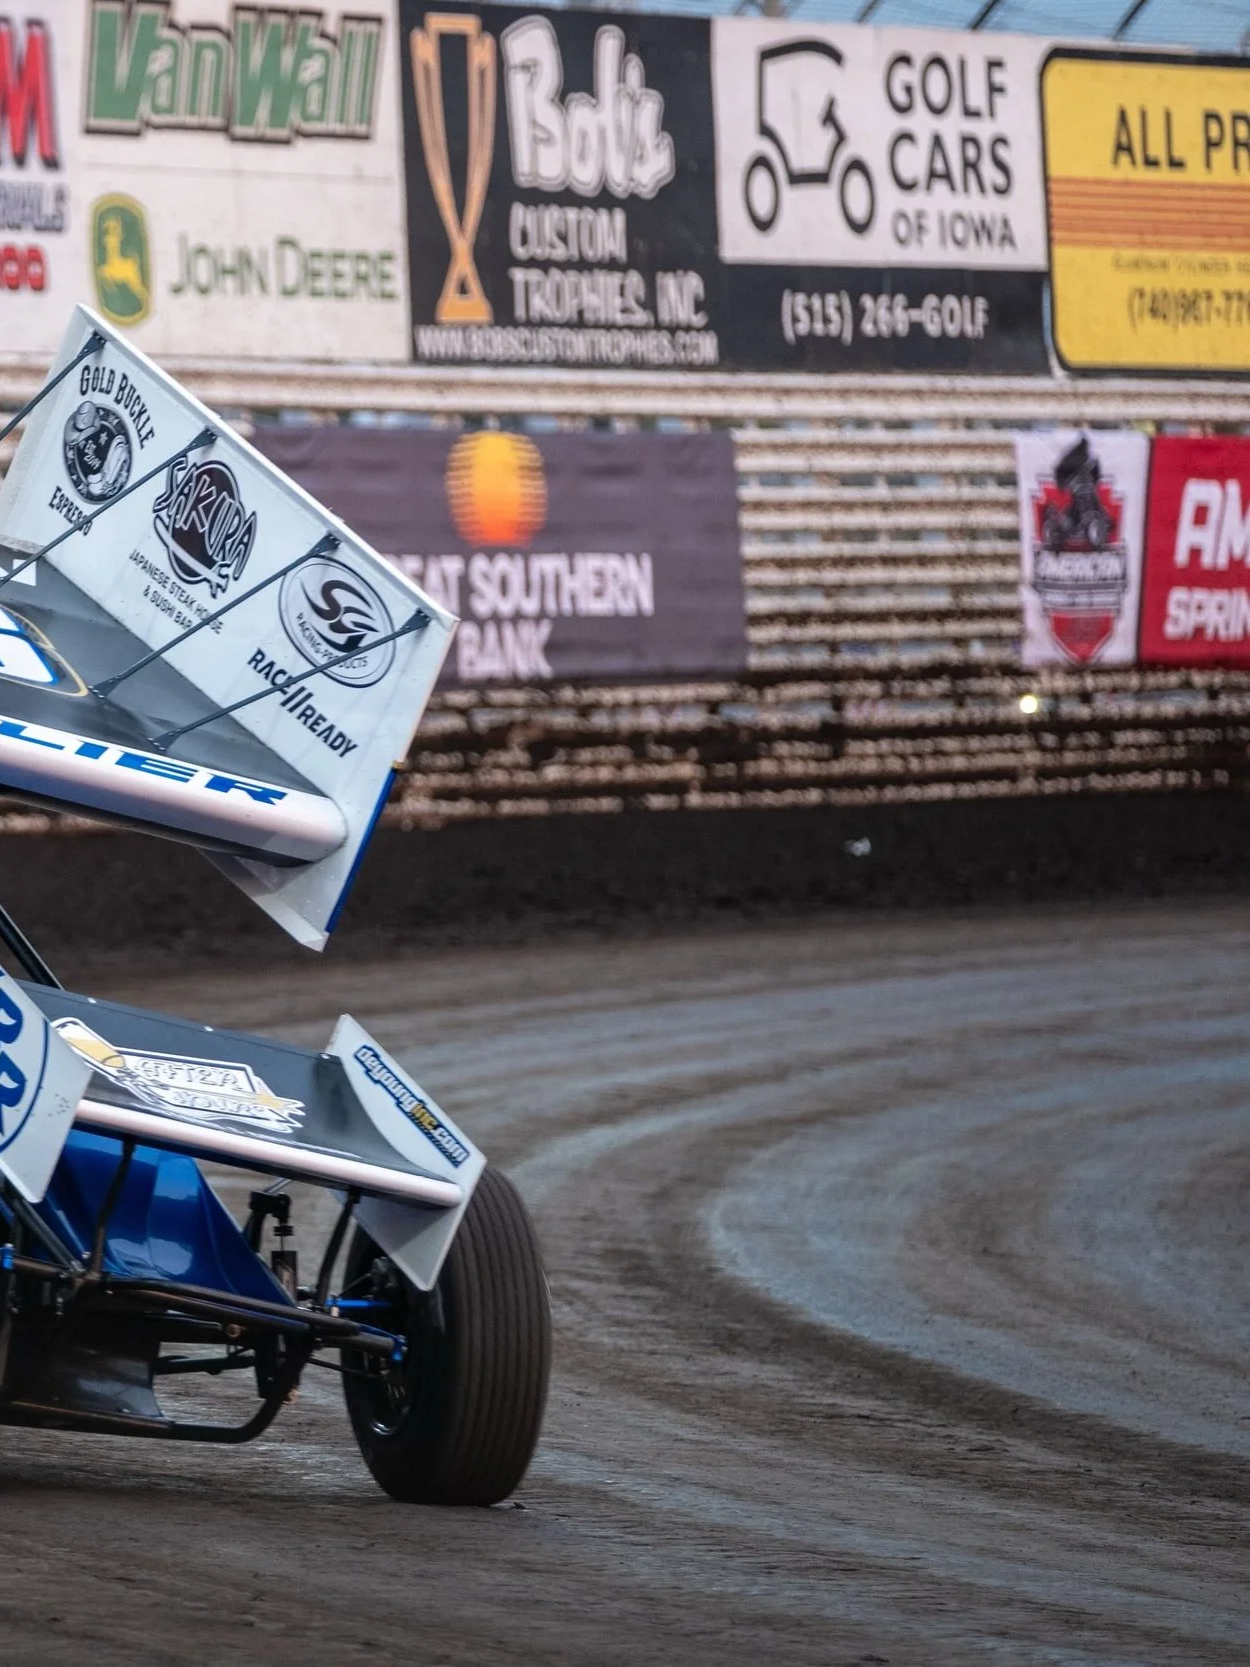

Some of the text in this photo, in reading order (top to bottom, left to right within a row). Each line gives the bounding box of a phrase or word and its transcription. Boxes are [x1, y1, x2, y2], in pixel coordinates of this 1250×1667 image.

[501, 14, 674, 198] Bob's
[884, 49, 1009, 118] GOLF
[888, 131, 1015, 198] CARS
[1111, 104, 1186, 170] ALL
[509, 202, 627, 264] CUSTOM
[891, 208, 1017, 252] OF IOWA
[170, 235, 397, 301] JOHN DEERE
[656, 270, 709, 328] INC
[782, 288, 989, 346] (515) 266-GOLF
[80, 365, 155, 450] GOLD BUCKLE
[128, 549, 224, 635] JAPANESE STEAK HOSE
[150, 590, 176, 620] SUSHI
[469, 551, 656, 617] SOUTHERN
[455, 620, 554, 681] BANK
